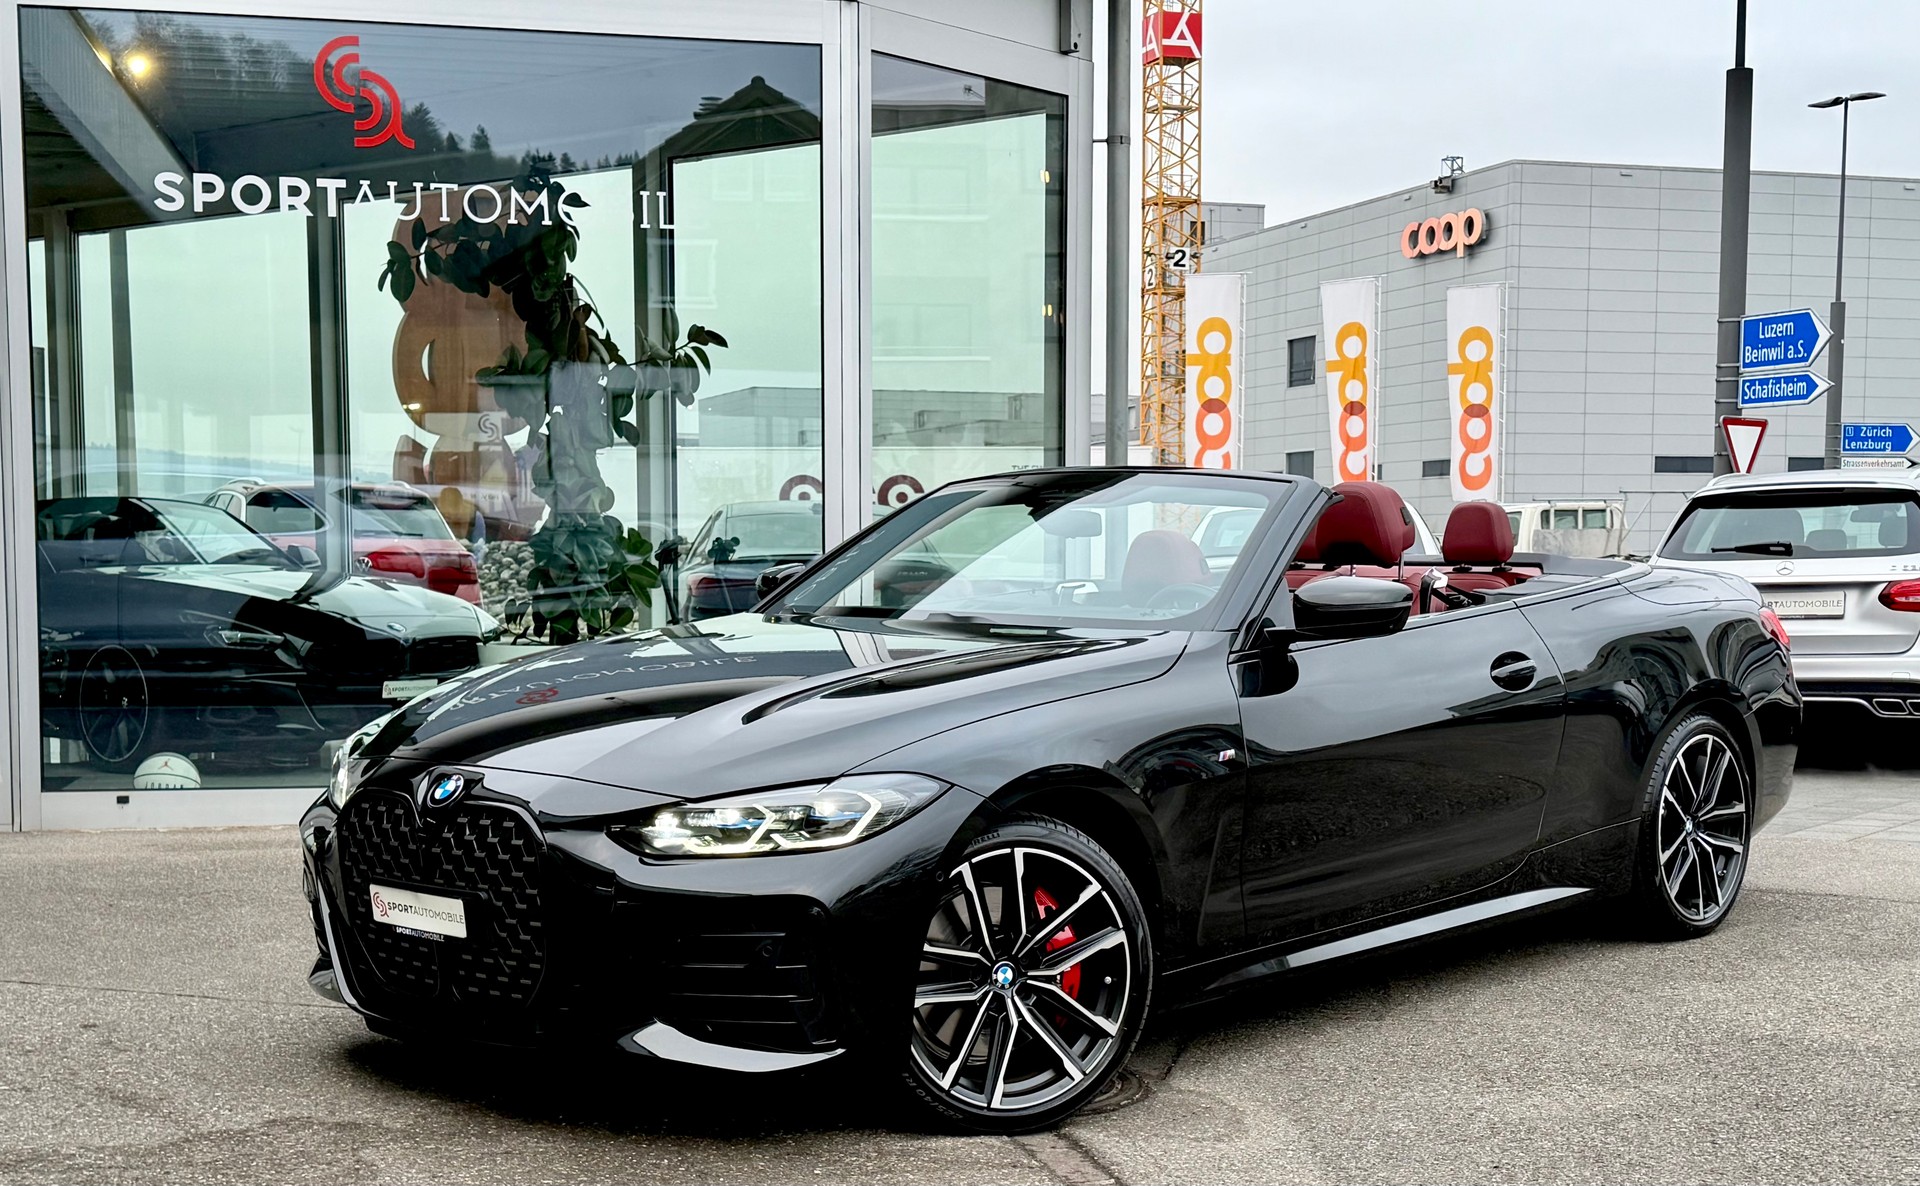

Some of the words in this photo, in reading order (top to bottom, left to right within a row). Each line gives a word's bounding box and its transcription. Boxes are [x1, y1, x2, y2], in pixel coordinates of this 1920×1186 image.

[1401, 208, 1483, 258] coop
[1173, 249, 1186, 267] 2
[1759, 322, 1794, 338] Luzern
[1745, 341, 1784, 363] Beinwil
[1787, 340, 1807, 358] a.S.
[1744, 378, 1807, 399] Schafisheim
[1447, 326, 1493, 491] coop
[1860, 426, 1892, 437] Zürich
[1845, 439, 1892, 452] Lenzburg
[1843, 459, 1904, 468] Strassenverkehrsamt
[387, 901, 465, 925] SPORTAUTOMOBILE
[396, 926, 445, 942] SPORTAUTOMOBILE
